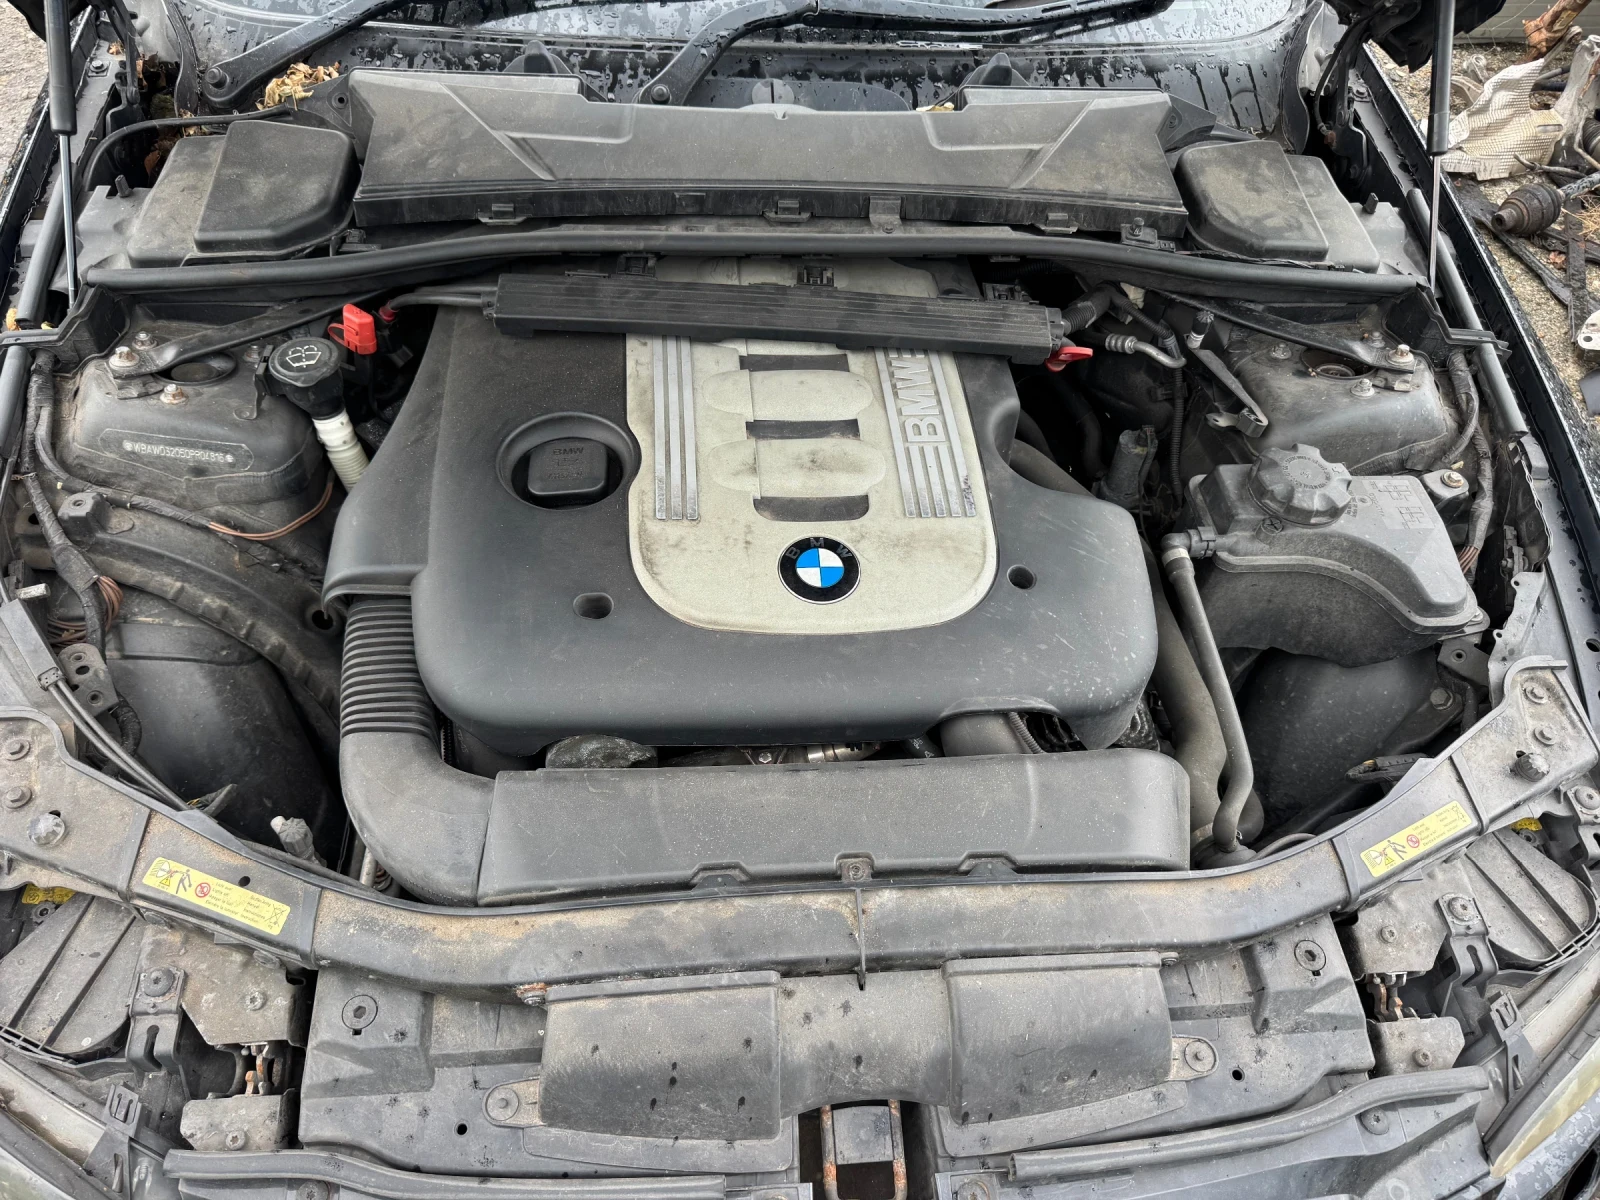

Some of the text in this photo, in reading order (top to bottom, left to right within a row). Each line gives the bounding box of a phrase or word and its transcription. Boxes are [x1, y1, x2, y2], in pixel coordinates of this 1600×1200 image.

[890, 359, 946, 442] BMW
[553, 446, 584, 456] BMW
[785, 537, 853, 560] BMW
